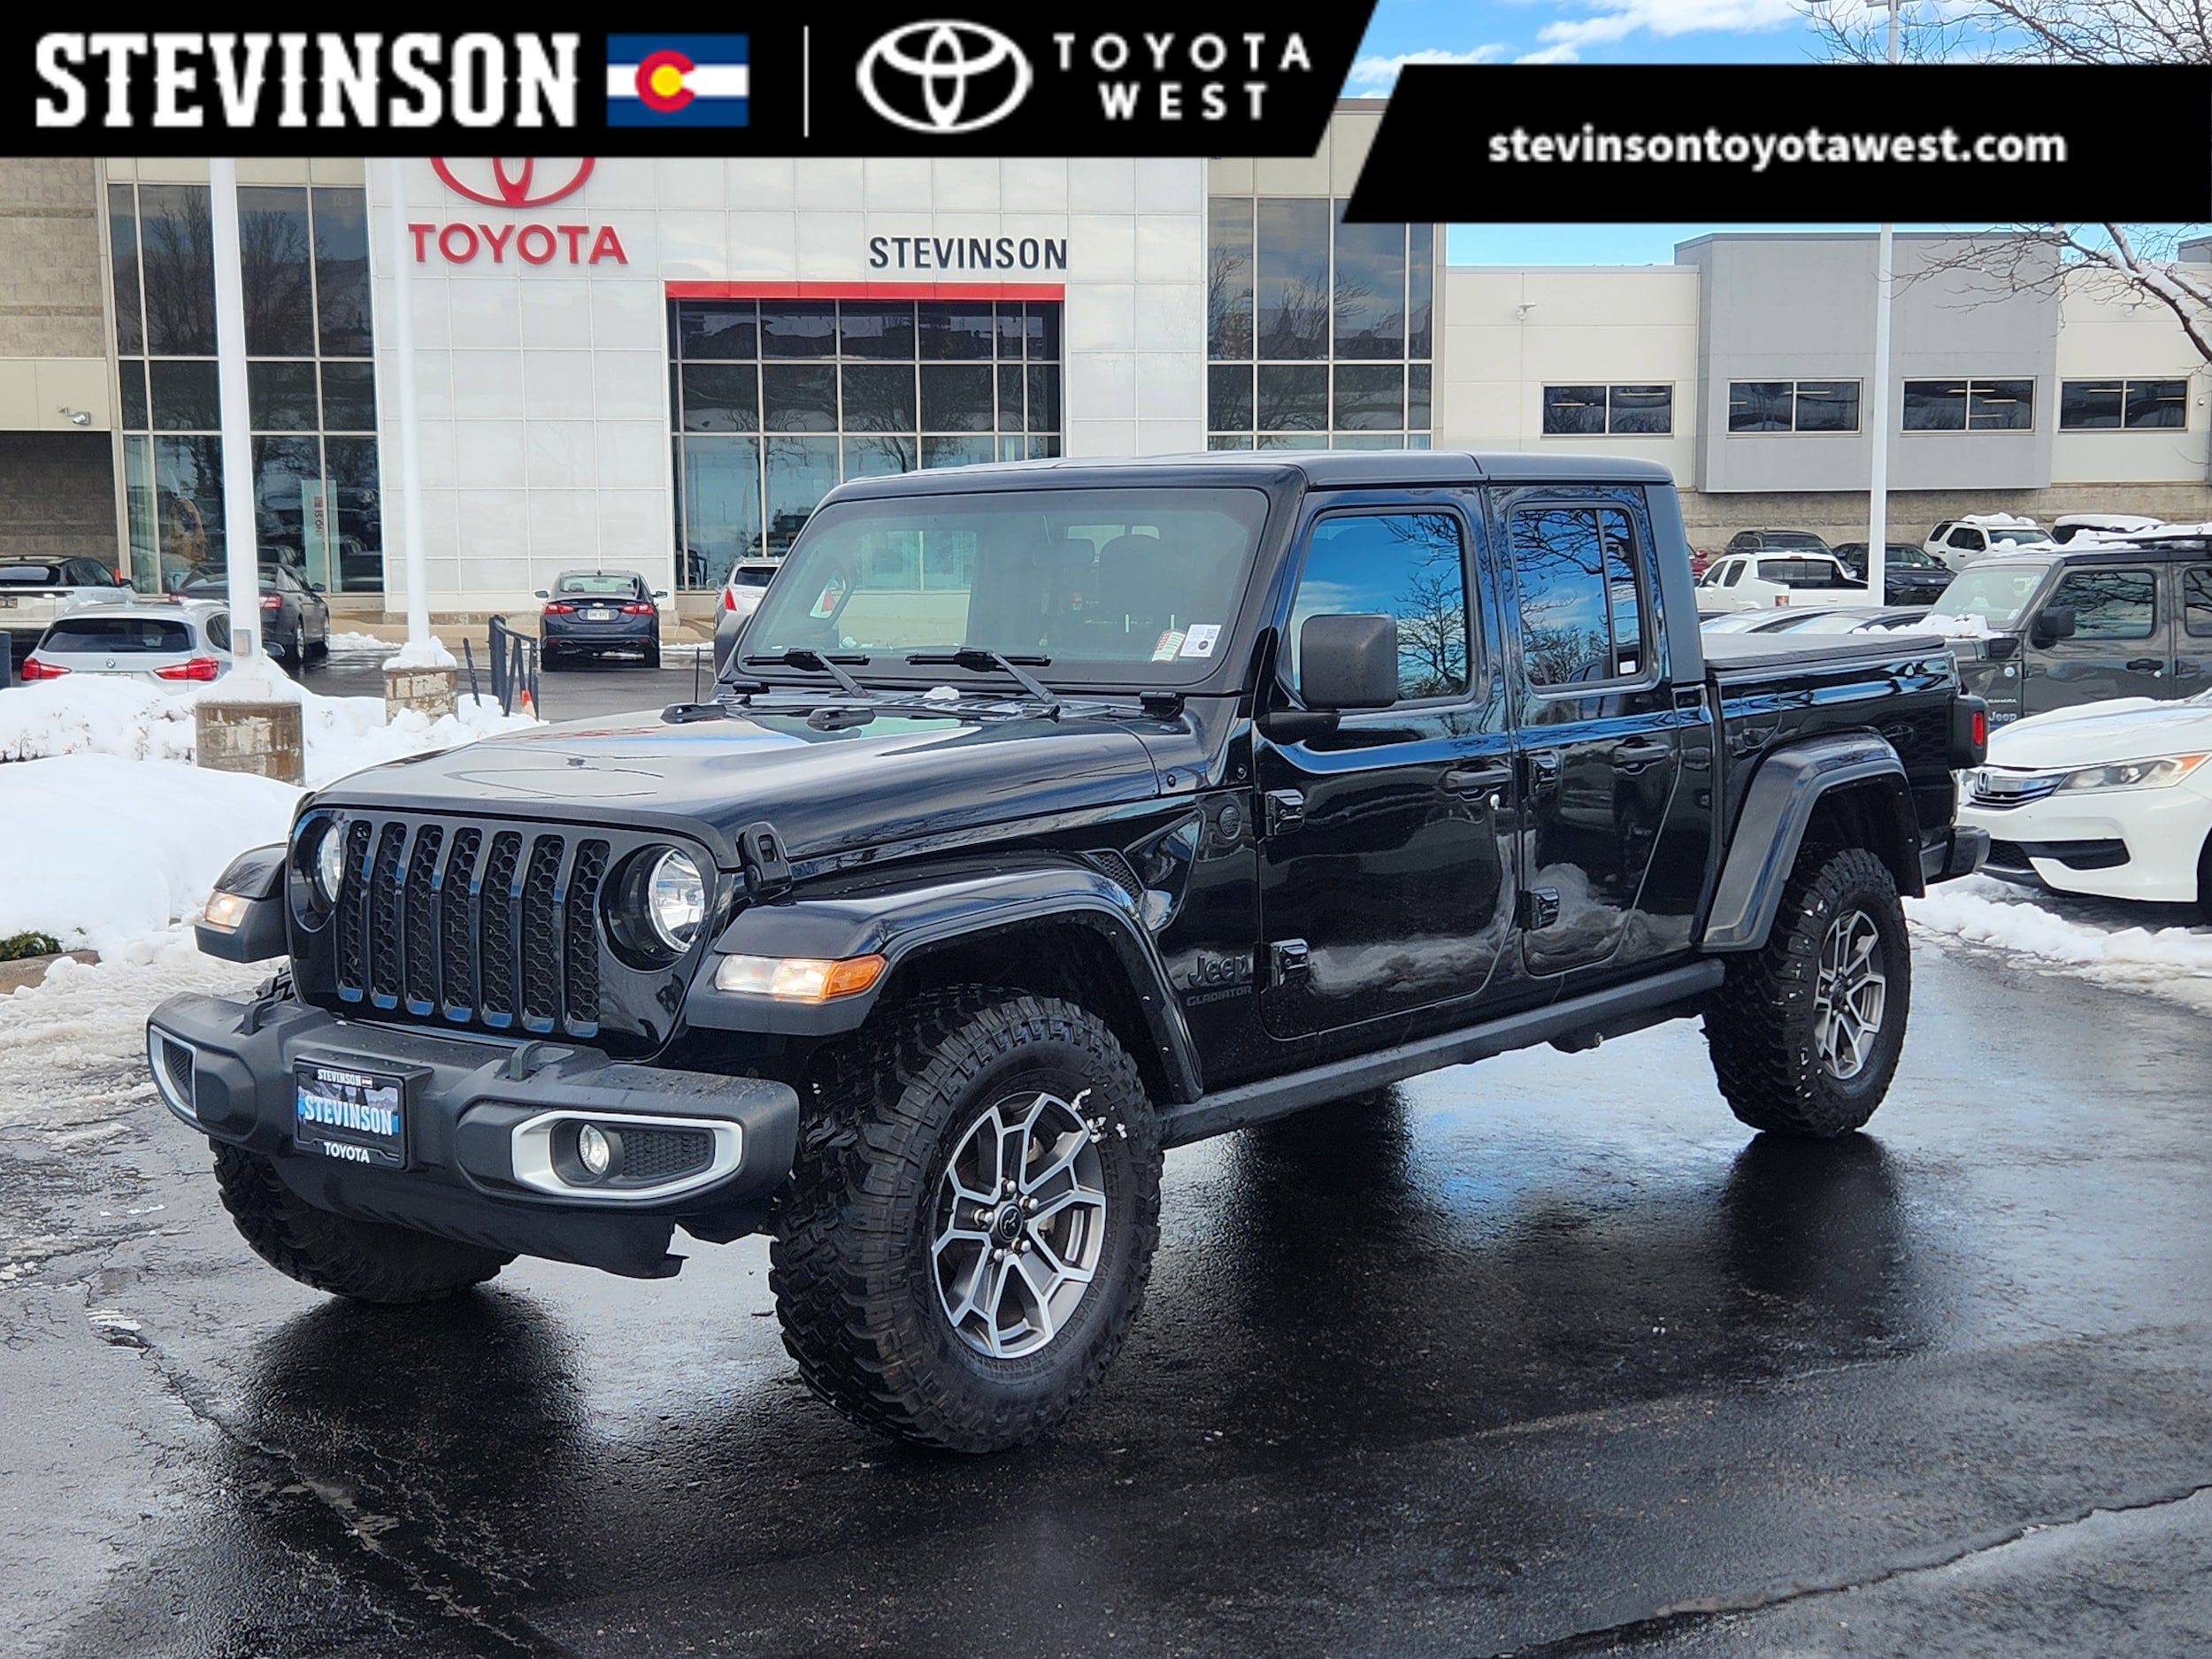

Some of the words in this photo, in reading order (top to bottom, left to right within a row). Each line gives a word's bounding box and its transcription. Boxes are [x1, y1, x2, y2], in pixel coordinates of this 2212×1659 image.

[408, 222, 626, 265] TOYOTA
[869, 235, 1068, 270] STEVINSON
[1988, 710, 2017, 723] Jeep
[1187, 955, 1248, 987] Jeep
[1187, 985, 1252, 1007] GLADIATOR
[318, 1069, 361, 1087] STEVINSON
[304, 1094, 392, 1136] STEVINSON
[324, 1141, 370, 1164] TOYOTA
